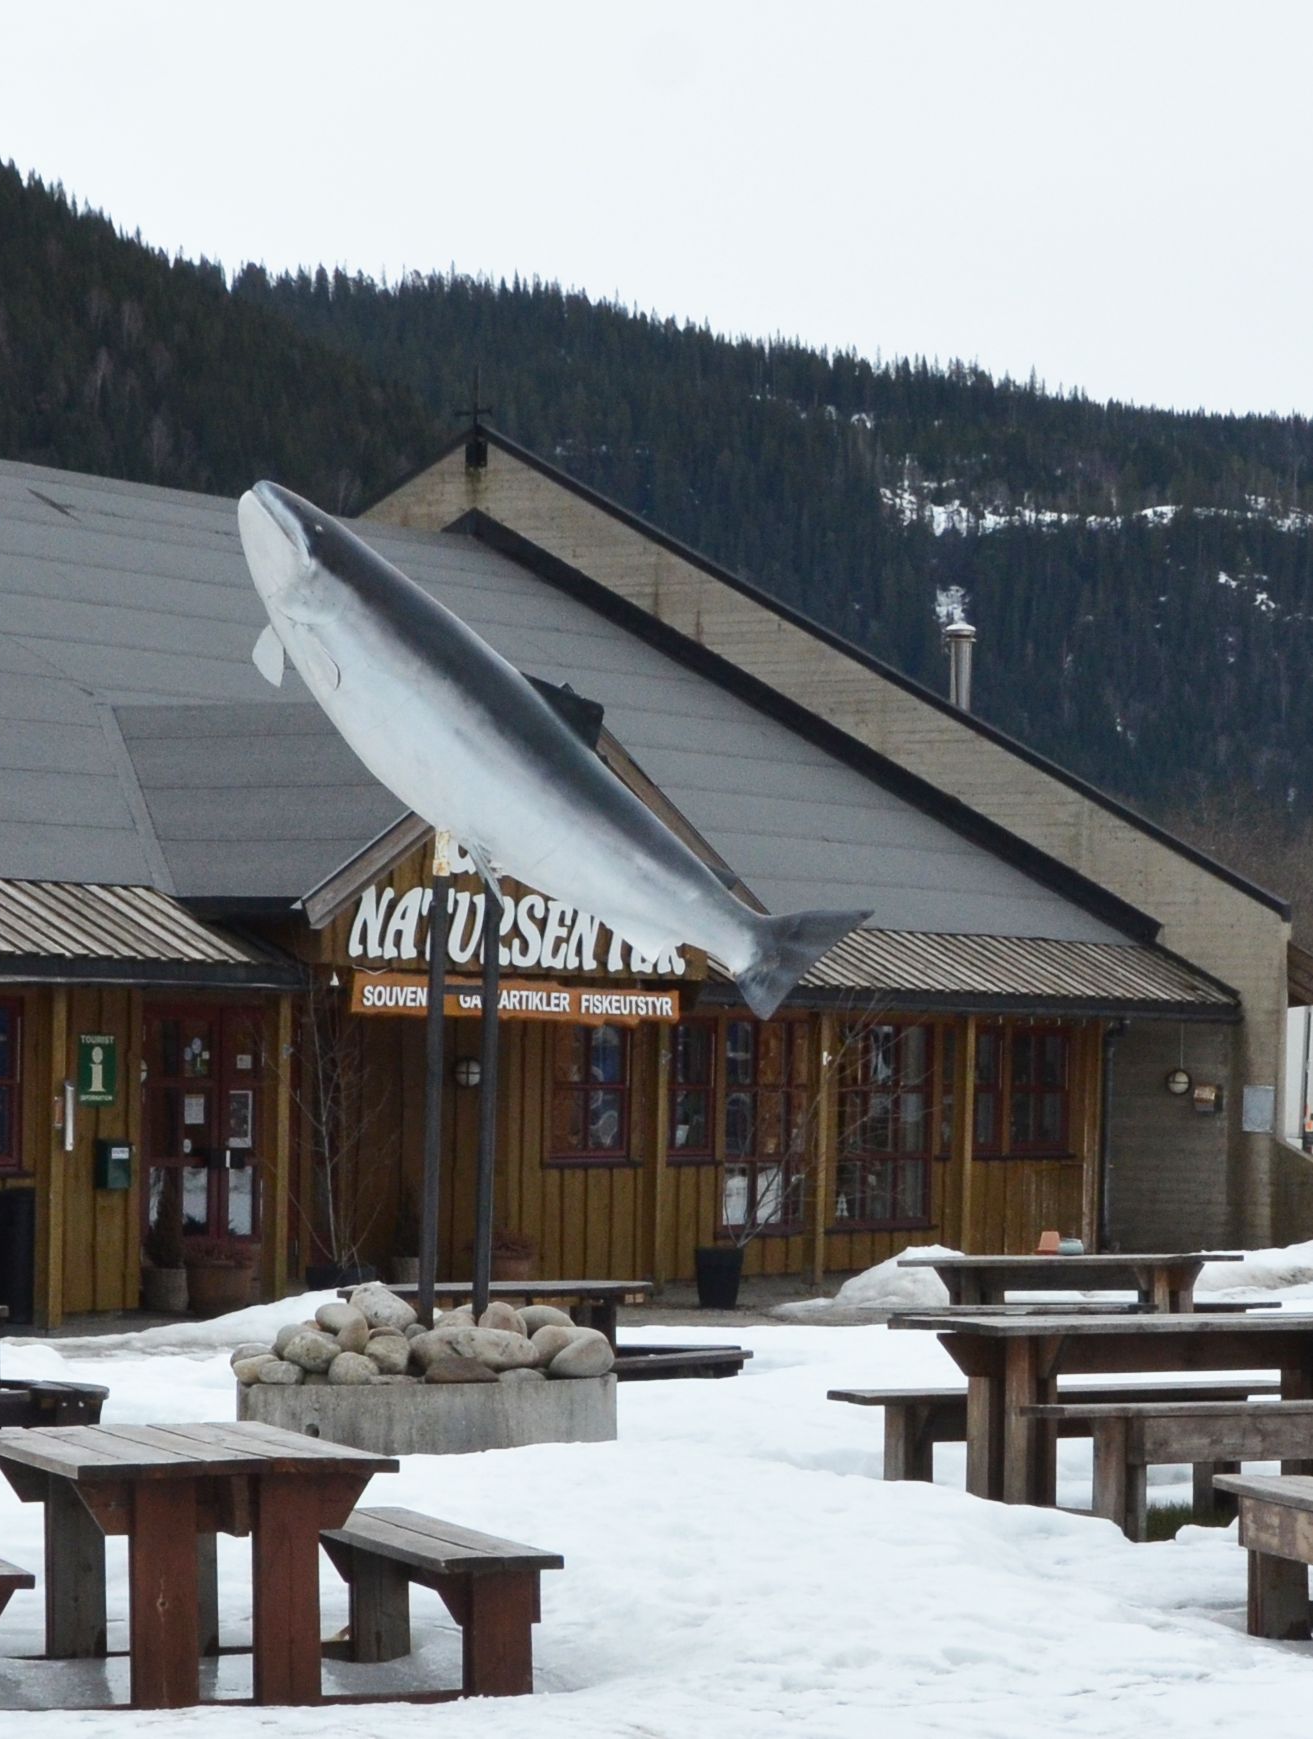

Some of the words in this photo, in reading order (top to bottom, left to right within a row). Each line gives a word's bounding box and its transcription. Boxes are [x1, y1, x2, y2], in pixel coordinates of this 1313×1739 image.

[363, 985, 427, 1006] SOUVEN
[459, 989, 570, 1012] GAARTIKLER
[581, 994, 672, 1016] FISKEUTSTYR
[80, 1034, 114, 1044] TOURIST
